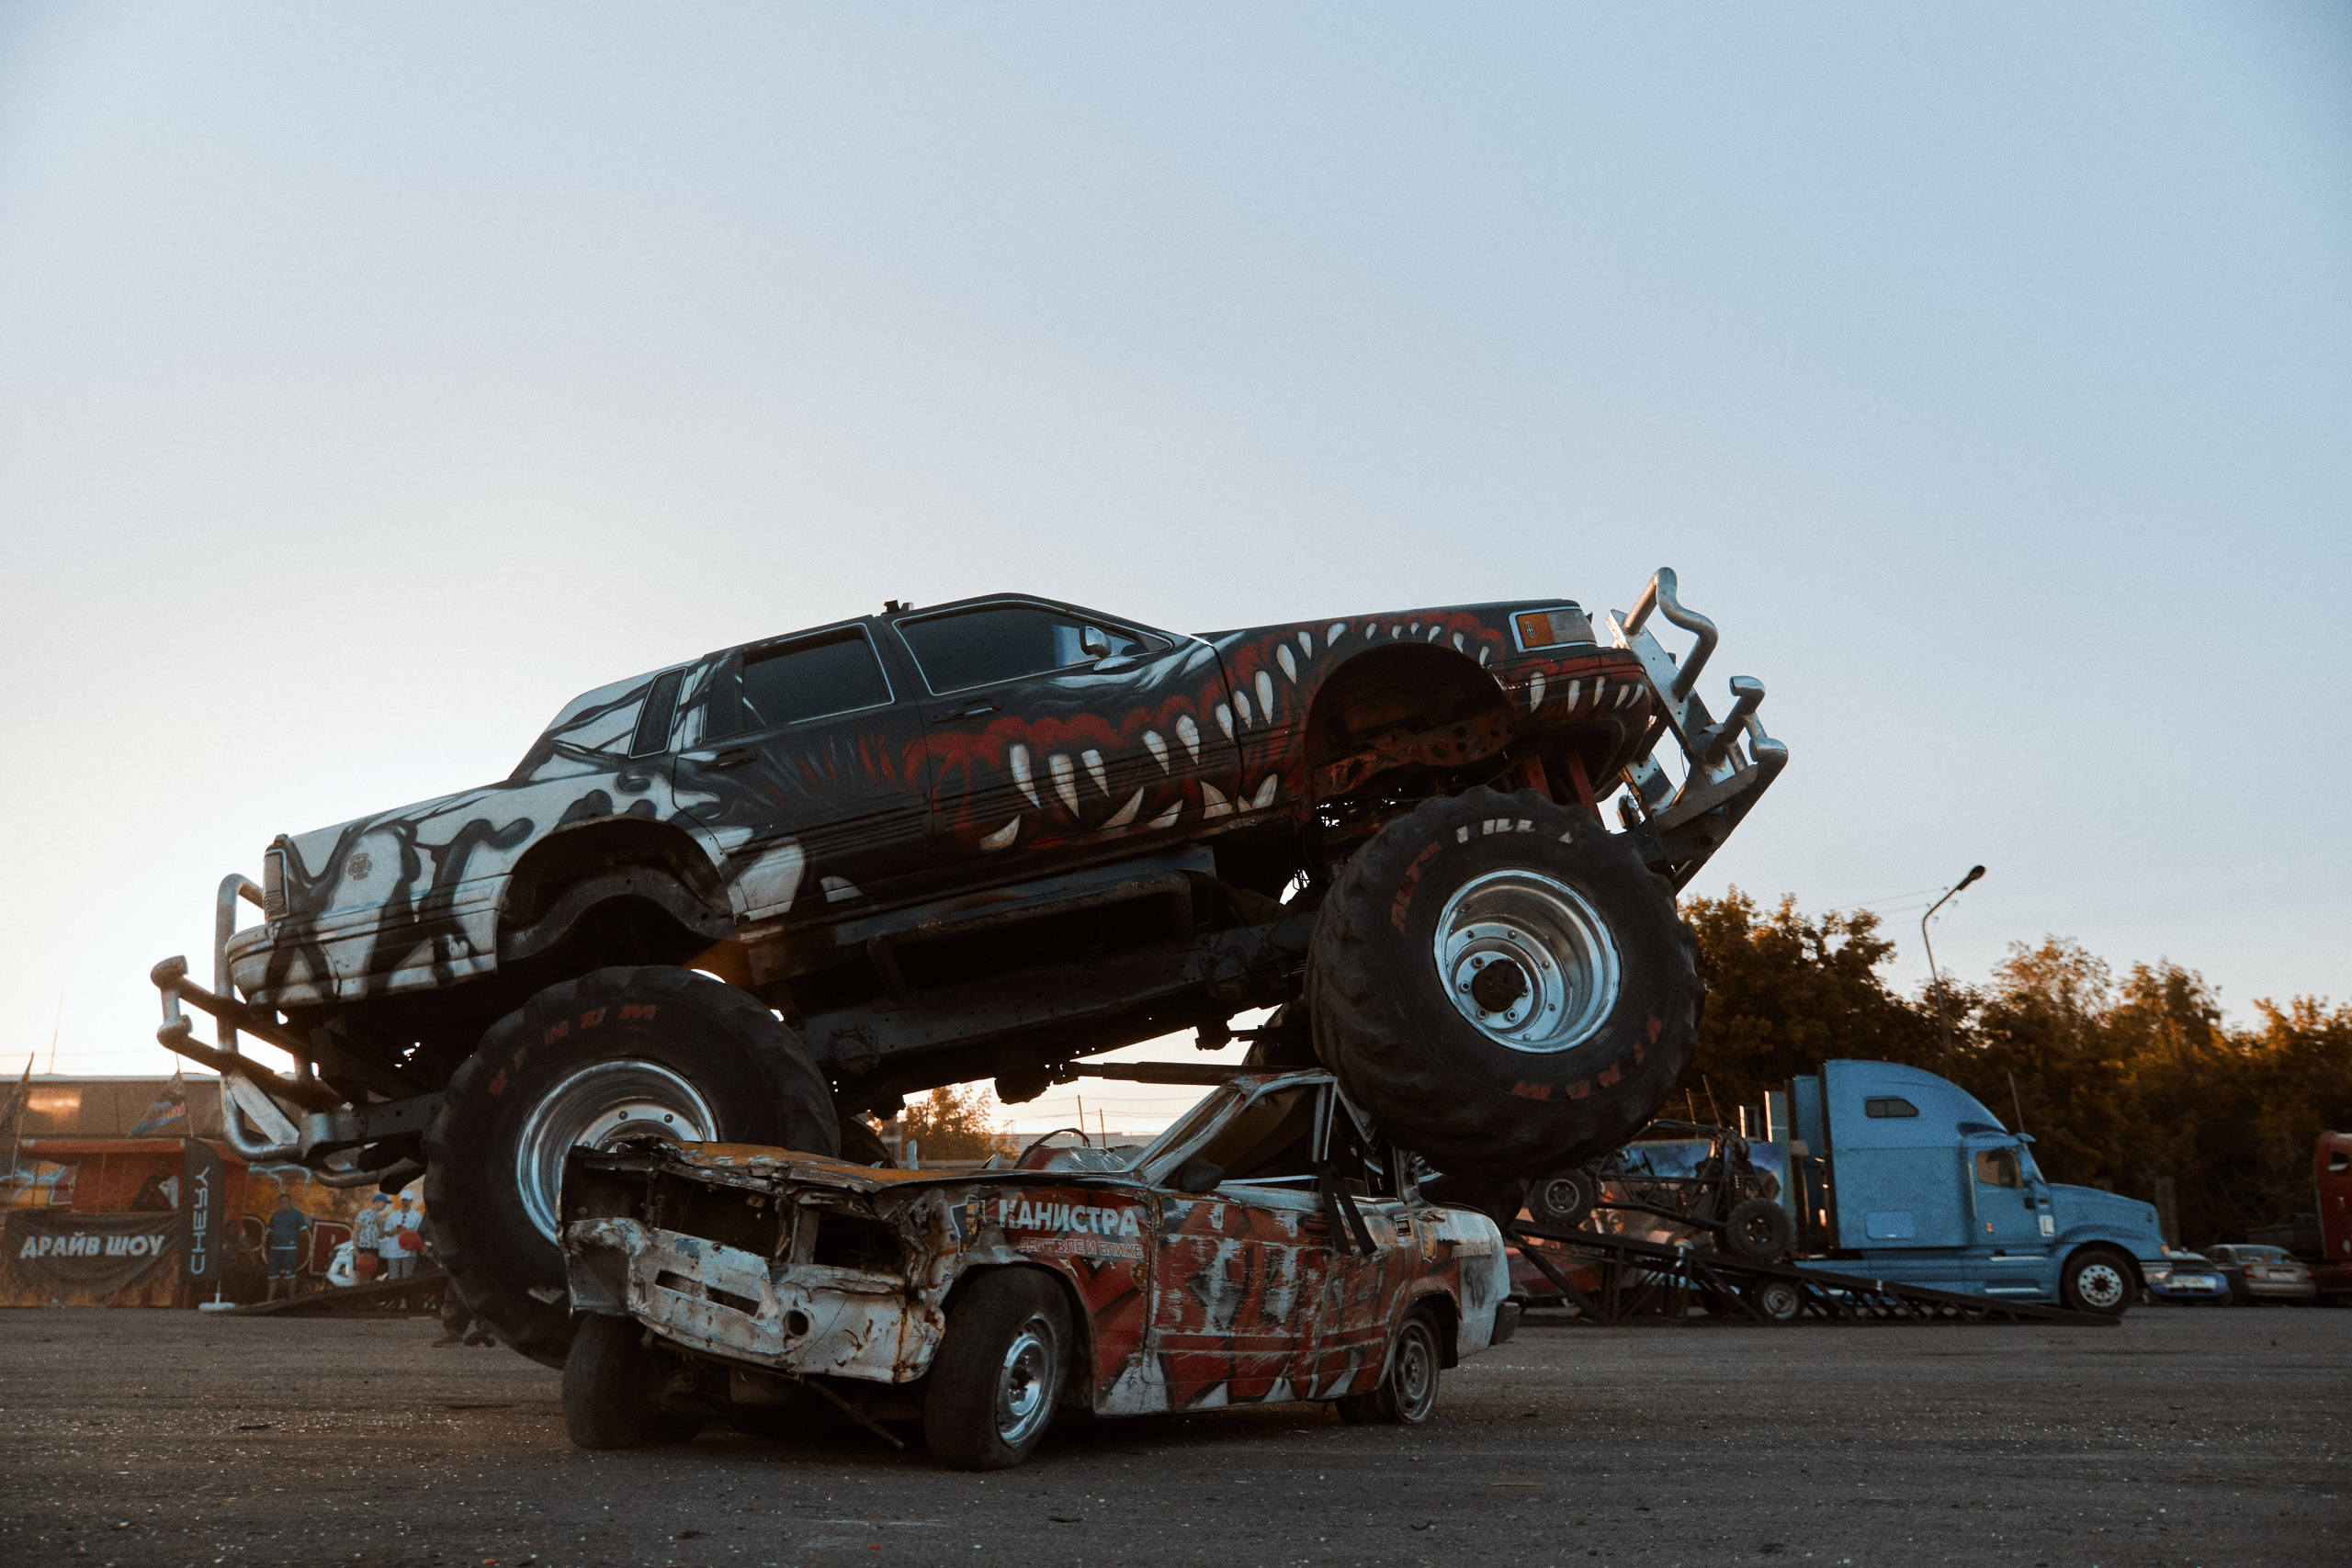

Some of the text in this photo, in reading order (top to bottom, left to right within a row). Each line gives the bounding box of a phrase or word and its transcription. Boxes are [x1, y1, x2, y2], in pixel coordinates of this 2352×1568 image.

[999, 1199, 1141, 1237] КАНИСТРА
[106, 1235, 165, 1257] ШОУ
[1087, 1240, 1098, 1256] И
[1100, 1241, 1144, 1258] БЛИЖЕ
